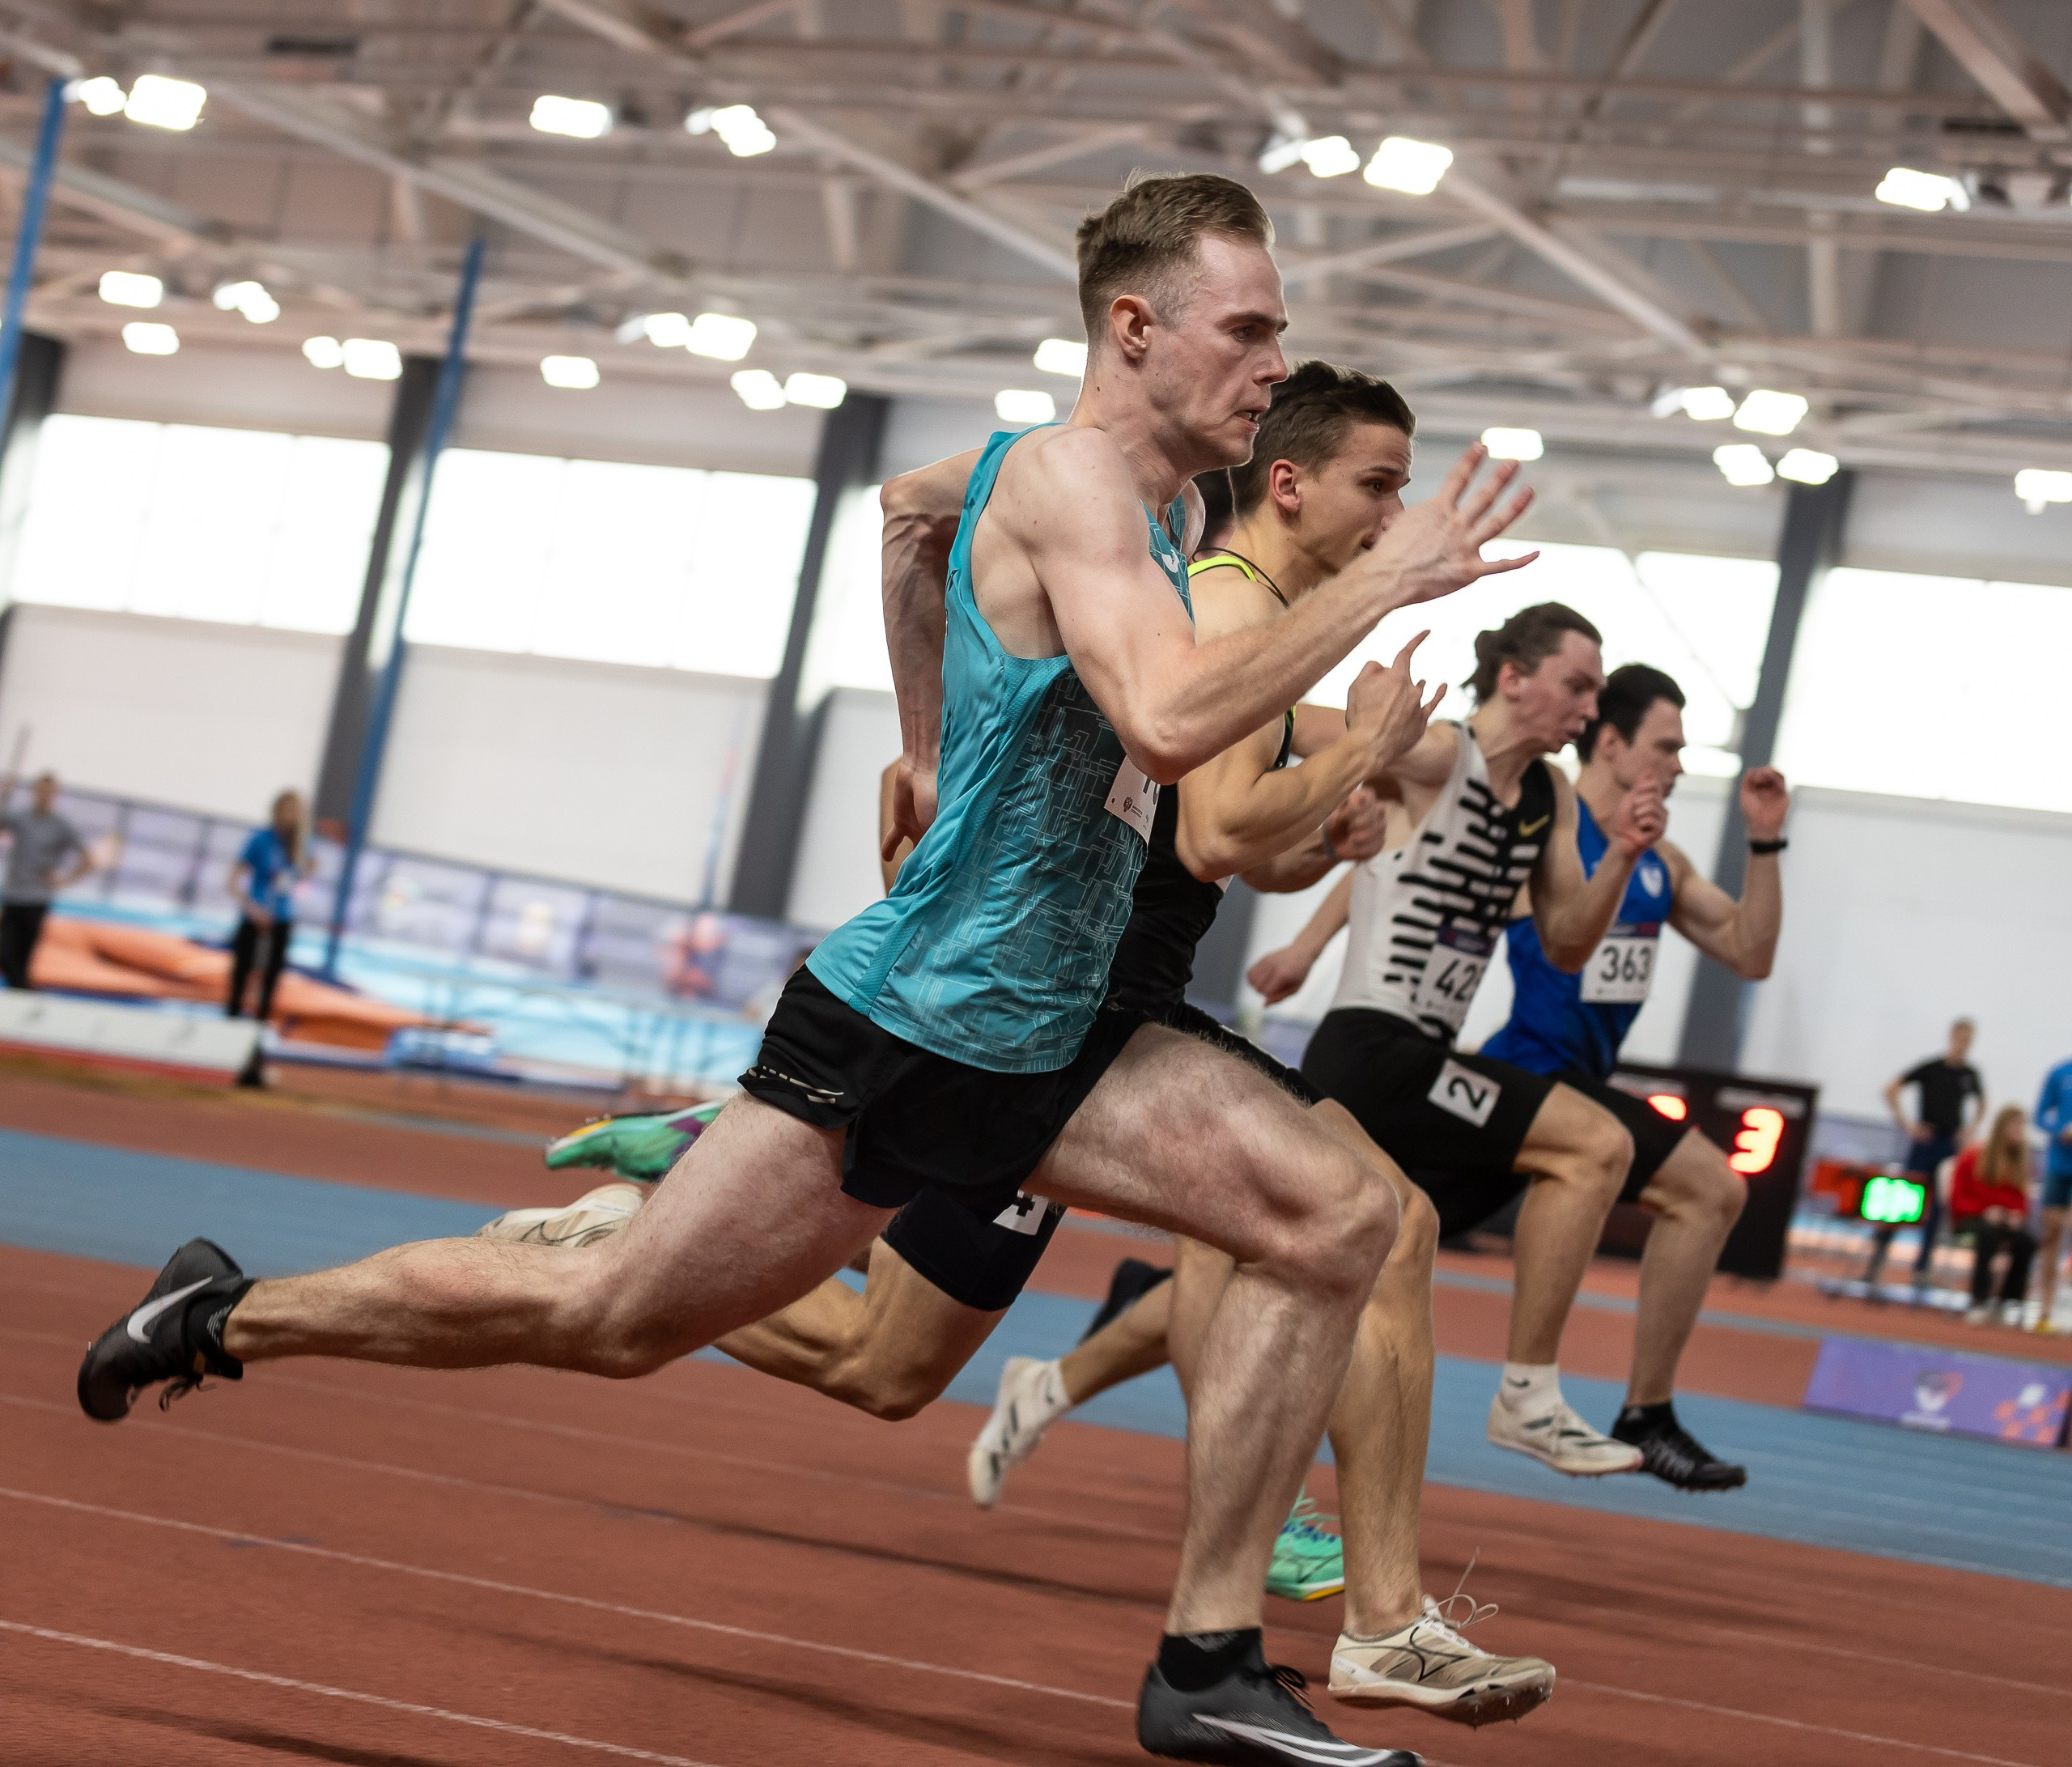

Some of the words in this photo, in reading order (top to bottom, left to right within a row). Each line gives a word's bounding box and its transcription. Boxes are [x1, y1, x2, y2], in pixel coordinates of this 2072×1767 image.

[1435, 958, 1483, 1001] 42
[1599, 945, 1651, 983] 363
[1447, 1076, 1488, 1111] 2
[1727, 1107, 1784, 1174] 3
